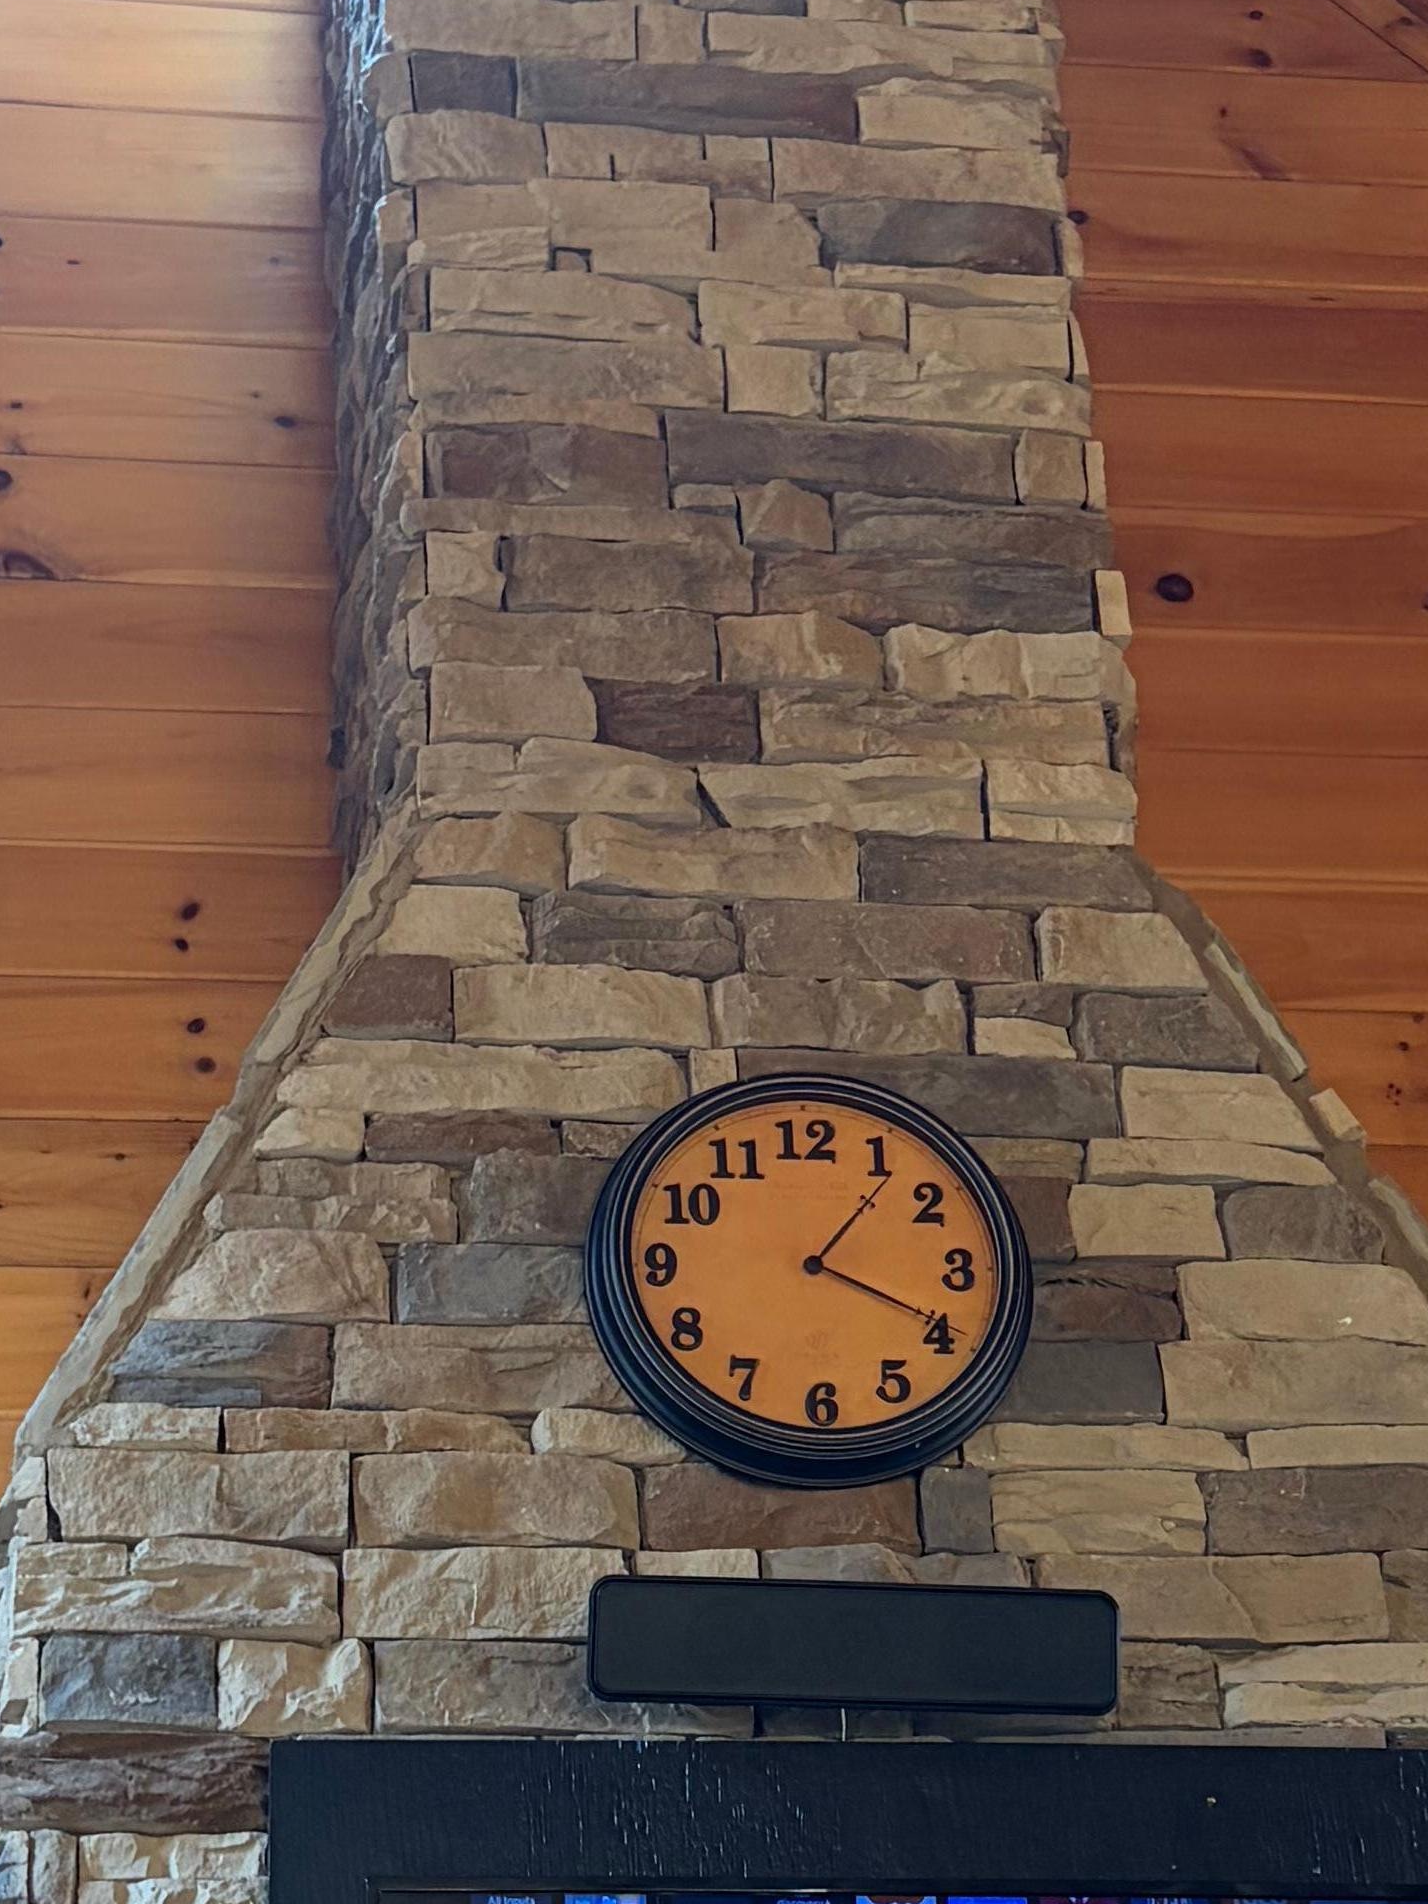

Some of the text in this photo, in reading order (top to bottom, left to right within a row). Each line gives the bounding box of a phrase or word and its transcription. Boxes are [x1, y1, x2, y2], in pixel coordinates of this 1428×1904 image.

[709, 1138, 765, 1180] 11
[775, 1119, 836, 1163] 12
[866, 1136, 892, 1177] 1
[663, 1183, 720, 1225] 10
[913, 1182, 945, 1227] 2
[645, 1243, 677, 1286] 9
[941, 1248, 975, 1291] 3
[671, 1307, 703, 1351] 8
[923, 1313, 955, 1354] 4
[729, 1355, 760, 1400] 7
[876, 1360, 911, 1403] 5
[805, 1383, 839, 1426] 6
